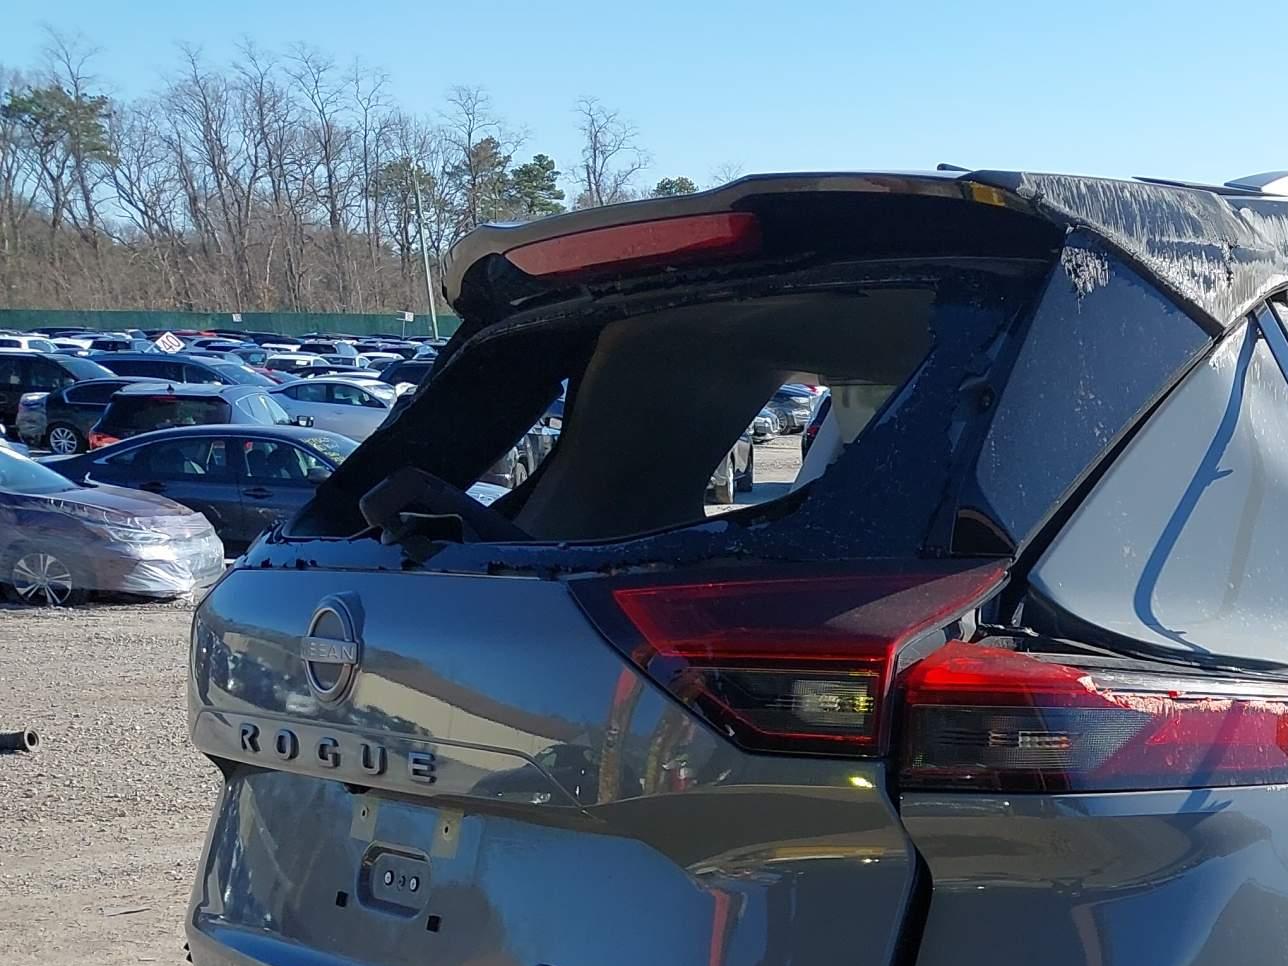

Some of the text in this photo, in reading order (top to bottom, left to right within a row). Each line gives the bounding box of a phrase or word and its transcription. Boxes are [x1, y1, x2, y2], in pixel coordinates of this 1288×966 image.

[160, 334, 181, 352] 40
[303, 641, 356, 661] SSAN
[239, 722, 437, 784] ROGUE
